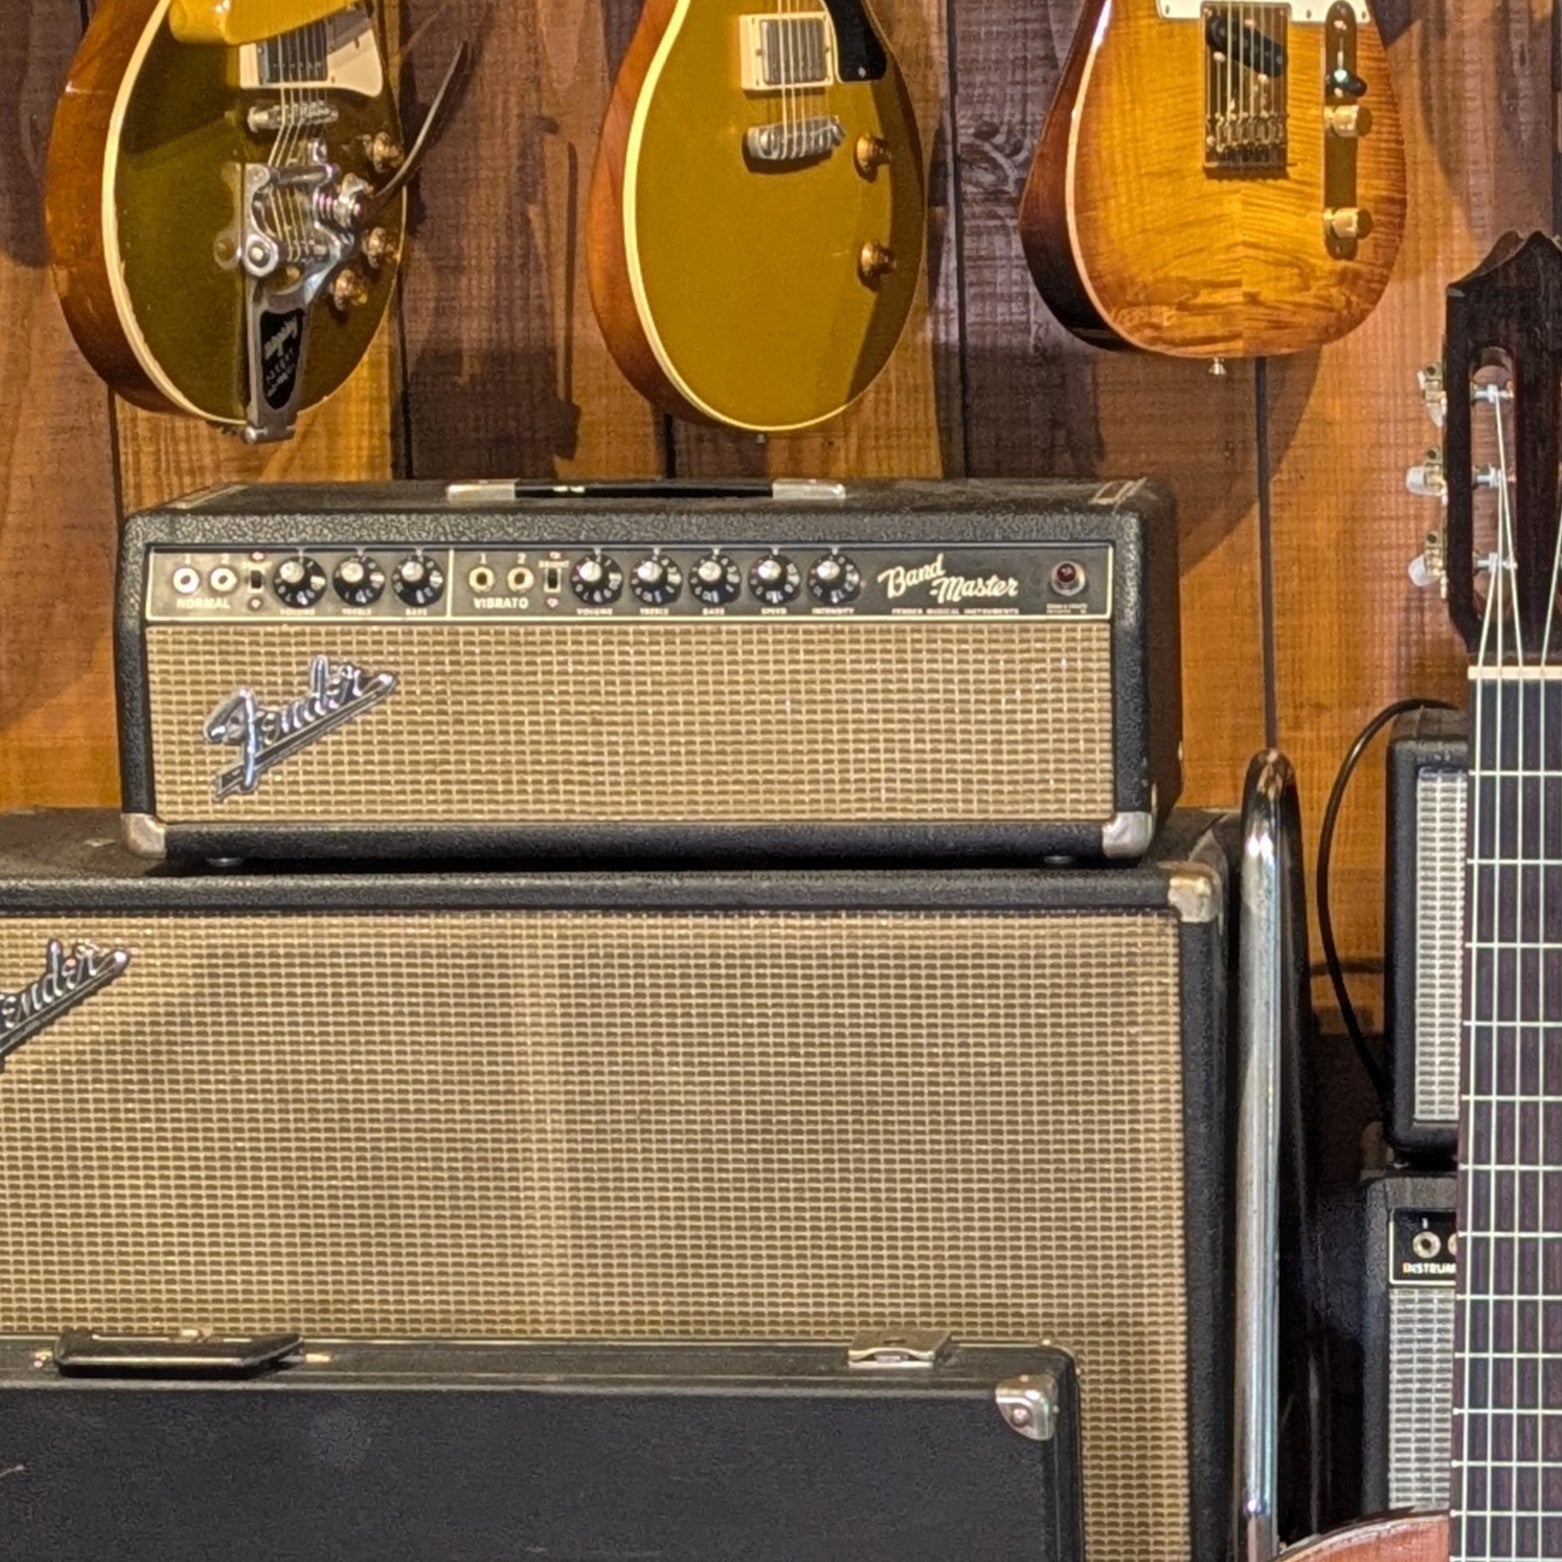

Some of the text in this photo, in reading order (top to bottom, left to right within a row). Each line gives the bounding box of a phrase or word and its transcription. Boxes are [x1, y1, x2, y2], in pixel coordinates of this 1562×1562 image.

[479, 553, 487, 565] 1
[517, 553, 527, 565] 2
[877, 553, 1019, 604] Band Master
[176, 597, 231, 610] NORMAL
[473, 597, 529, 610] VIBRATO
[204, 655, 397, 799] Fender
